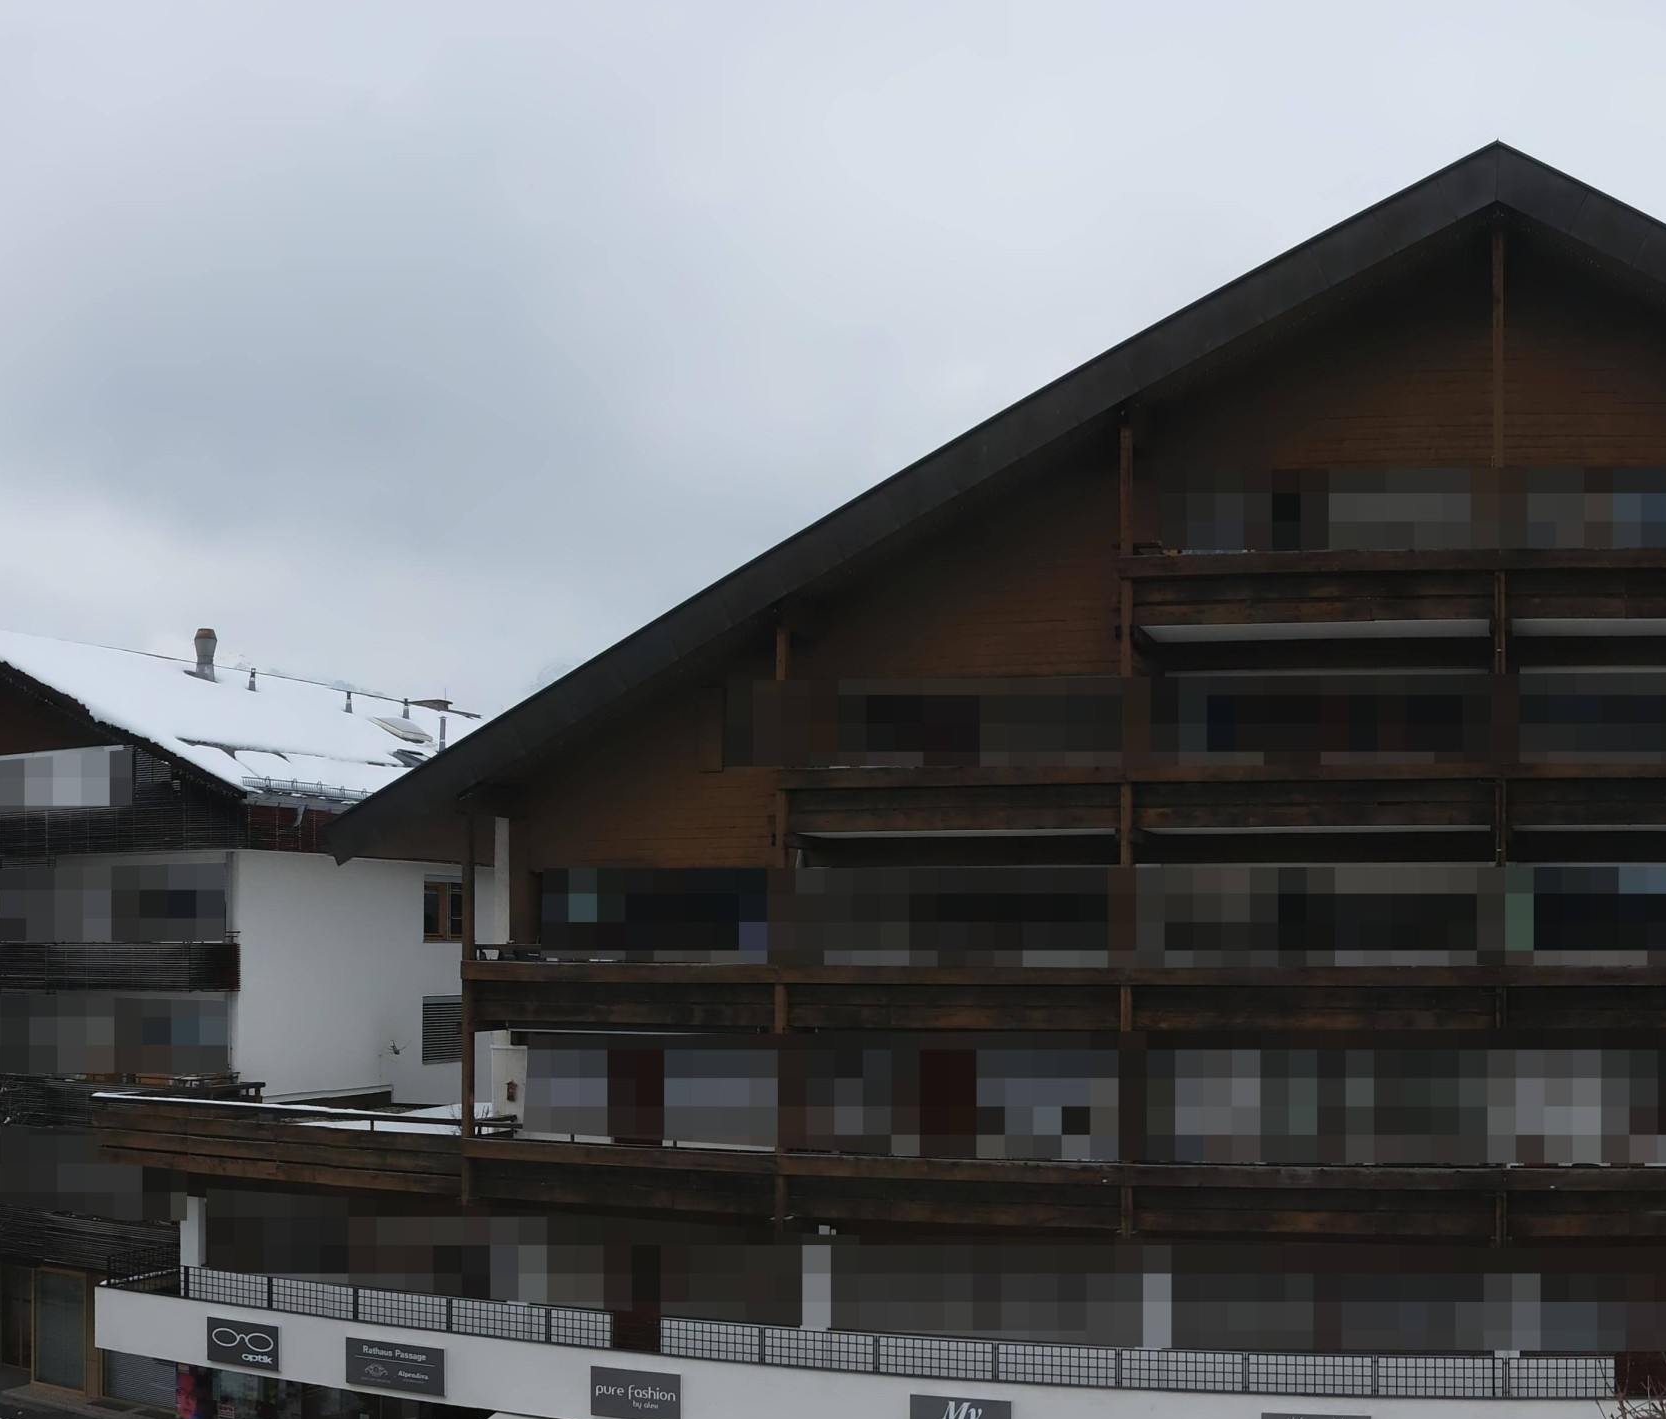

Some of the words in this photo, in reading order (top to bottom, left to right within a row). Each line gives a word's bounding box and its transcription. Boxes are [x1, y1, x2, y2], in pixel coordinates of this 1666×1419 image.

[241, 1353, 273, 1364] optik
[362, 1345, 393, 1357] Rathaus
[395, 1349, 427, 1362] Passage
[595, 1384, 624, 1397] pure
[628, 1384, 676, 1402] fashion
[633, 1400, 643, 1410] by
